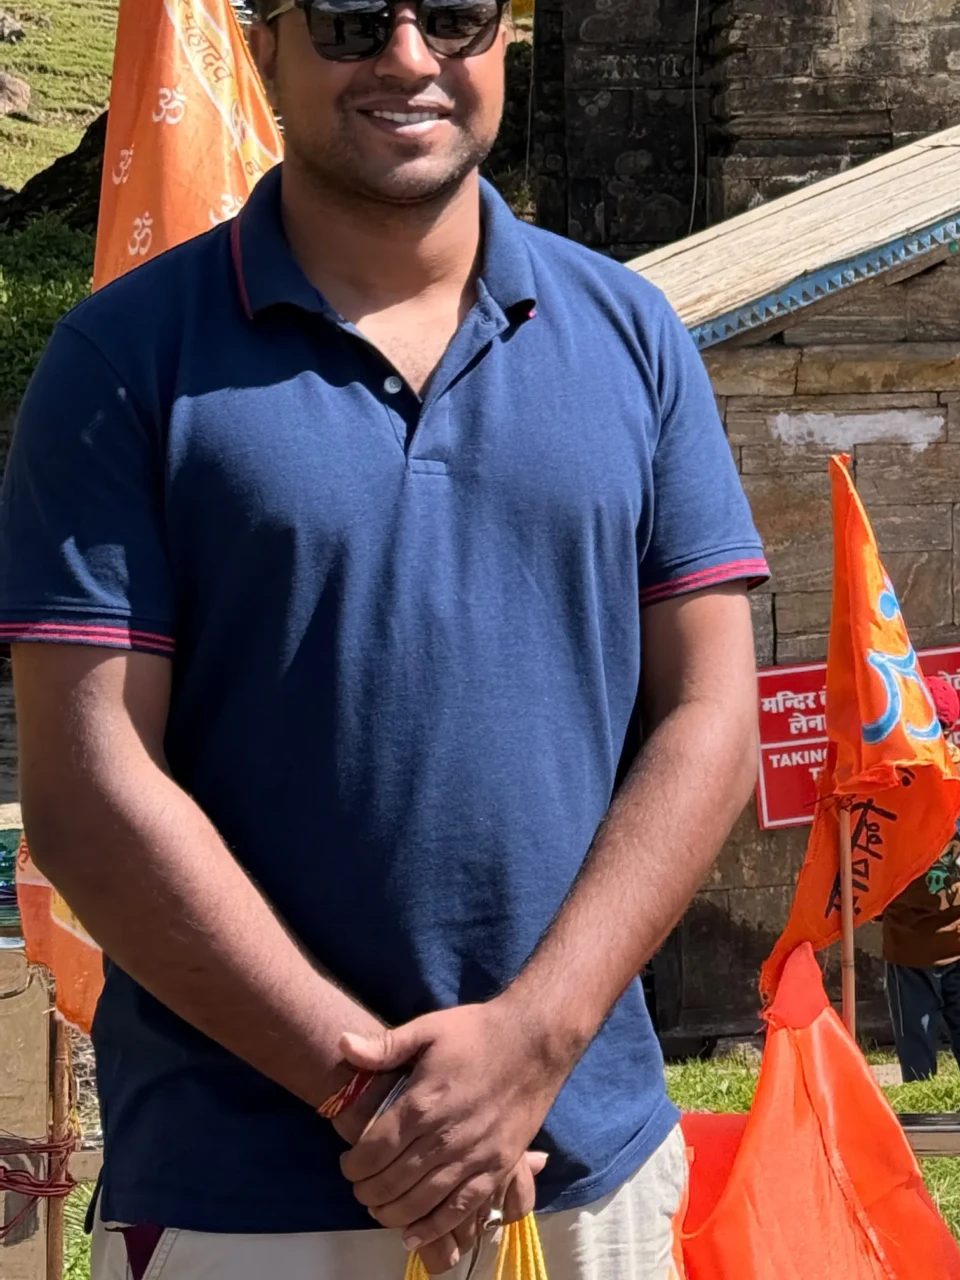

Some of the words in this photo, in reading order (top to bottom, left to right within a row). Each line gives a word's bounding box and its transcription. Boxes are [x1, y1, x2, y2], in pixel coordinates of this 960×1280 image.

[152, 87, 187, 125] ॐ
[128, 211, 154, 256] ॐ
[761, 690, 817, 714] मन्दिर
